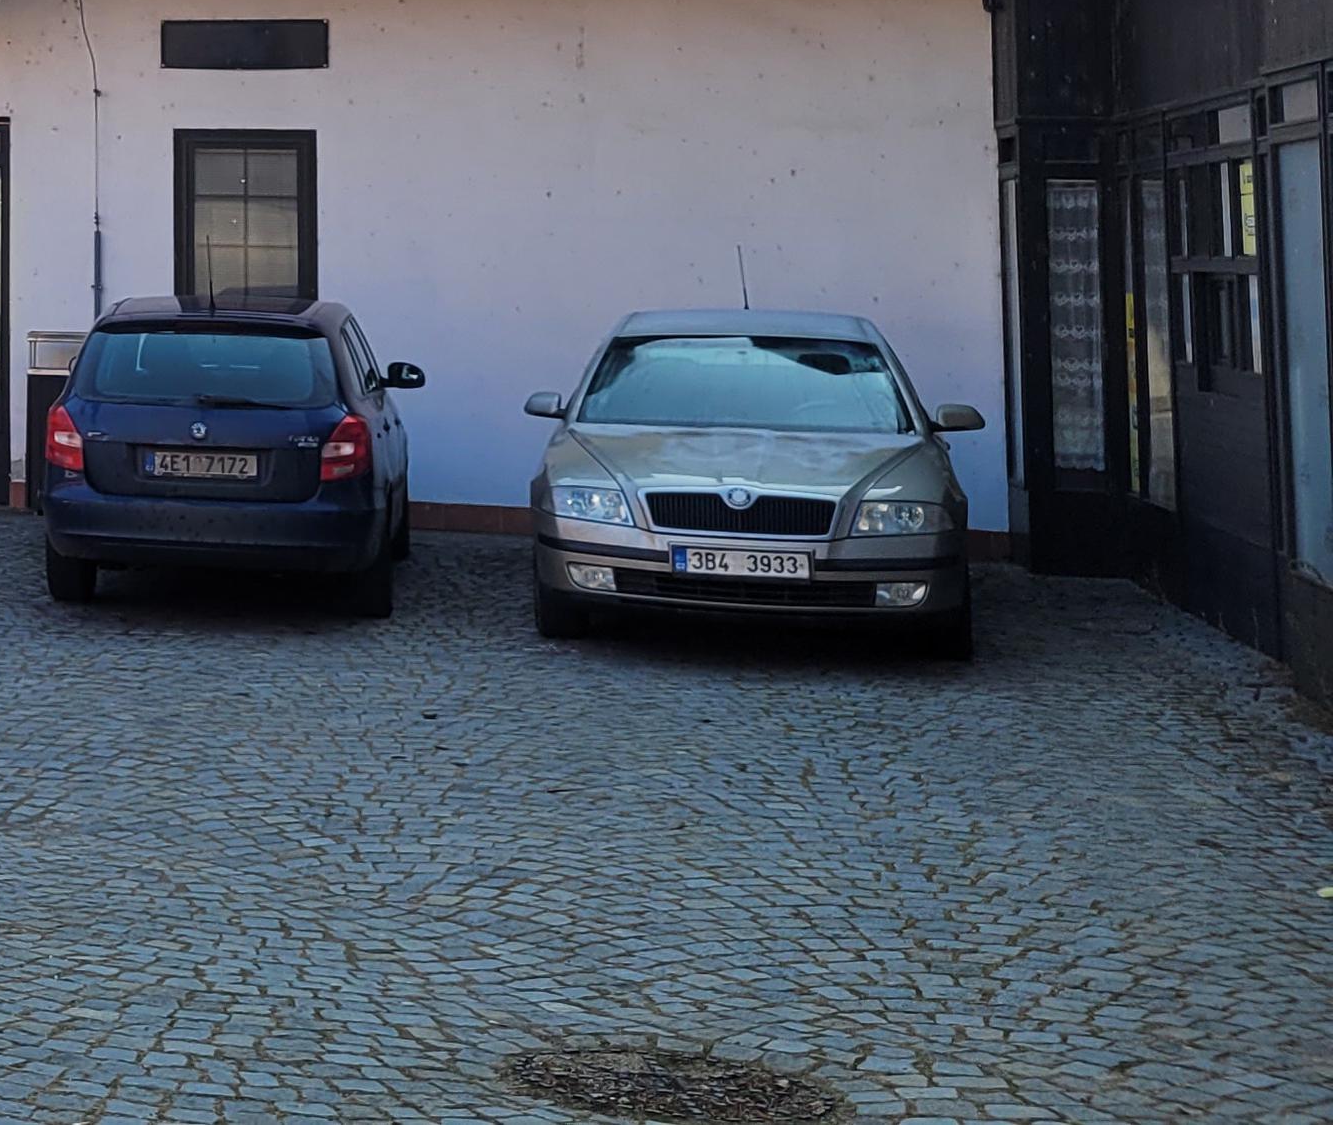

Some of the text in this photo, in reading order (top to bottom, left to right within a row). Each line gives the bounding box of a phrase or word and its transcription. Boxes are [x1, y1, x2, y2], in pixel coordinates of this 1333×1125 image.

[159, 454, 190, 472] 4E1
[207, 456, 249, 474] 7172
[691, 552, 729, 572] 3B4
[746, 554, 799, 574] 3933
